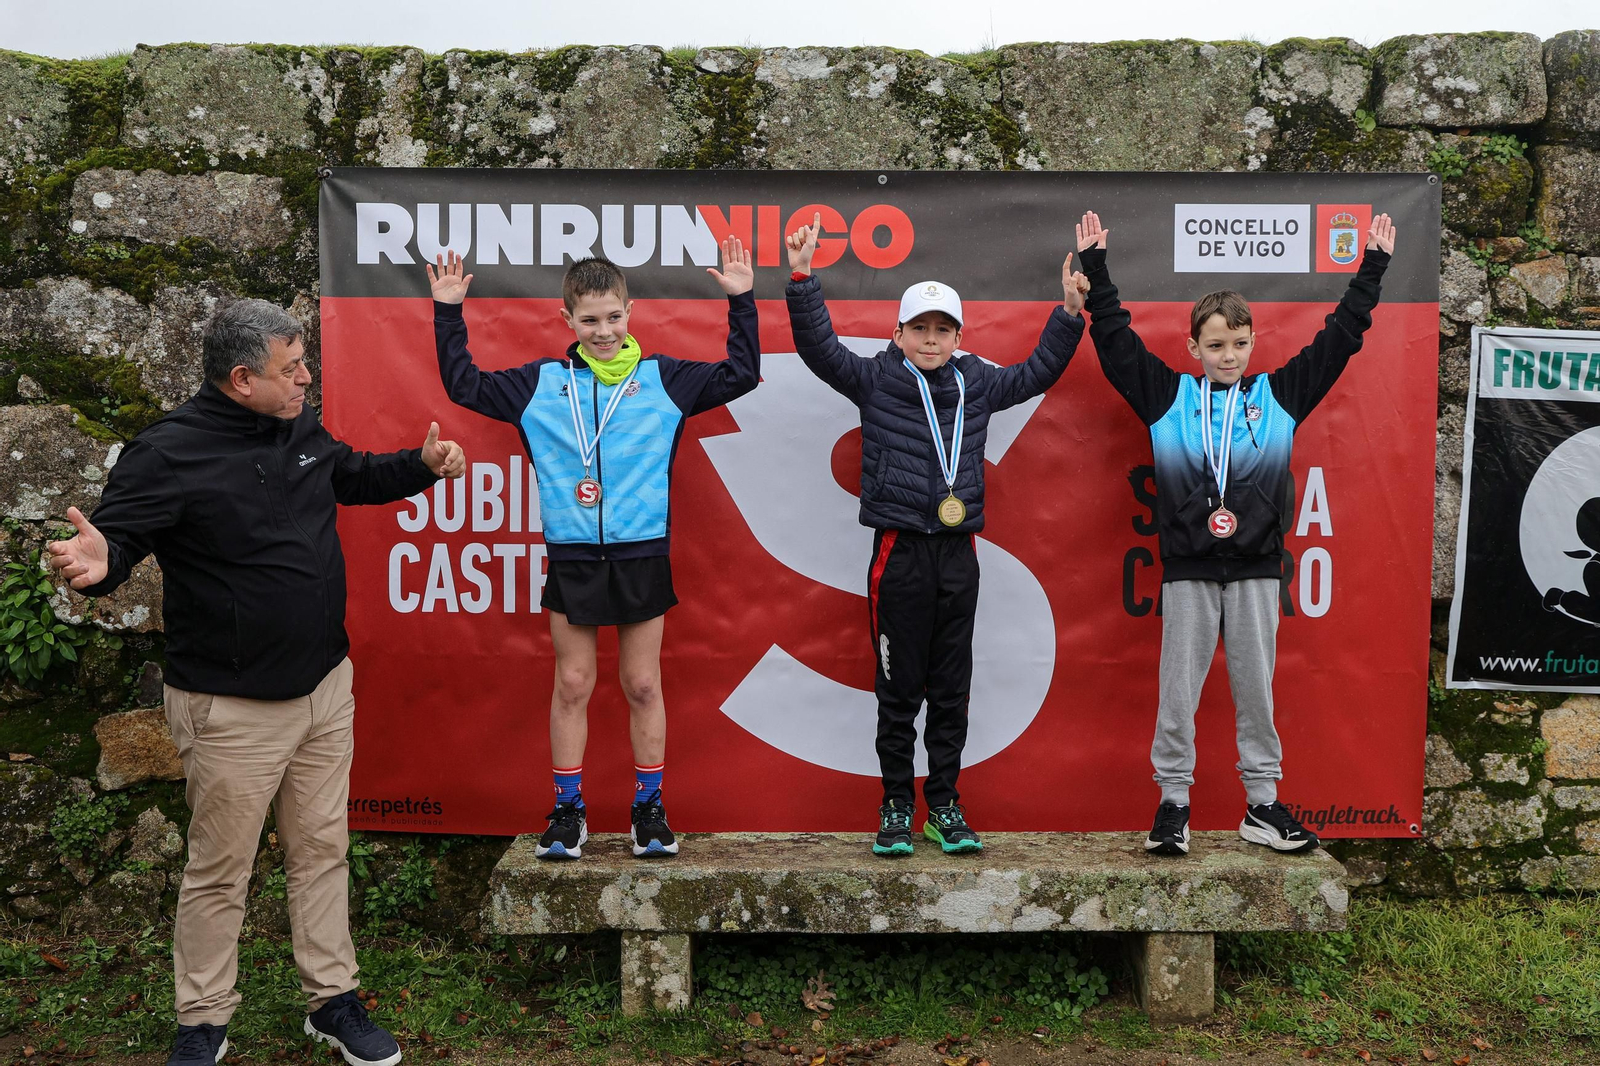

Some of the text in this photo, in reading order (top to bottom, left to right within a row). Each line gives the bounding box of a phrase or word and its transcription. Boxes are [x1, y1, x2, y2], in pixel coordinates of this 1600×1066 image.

[1184, 218, 1299, 235] CONCELLO
[1198, 241, 1285, 257] DE VIGO
[1479, 650, 1600, 674] www.fruta
[1284, 802, 1407, 831] ingletrack.
